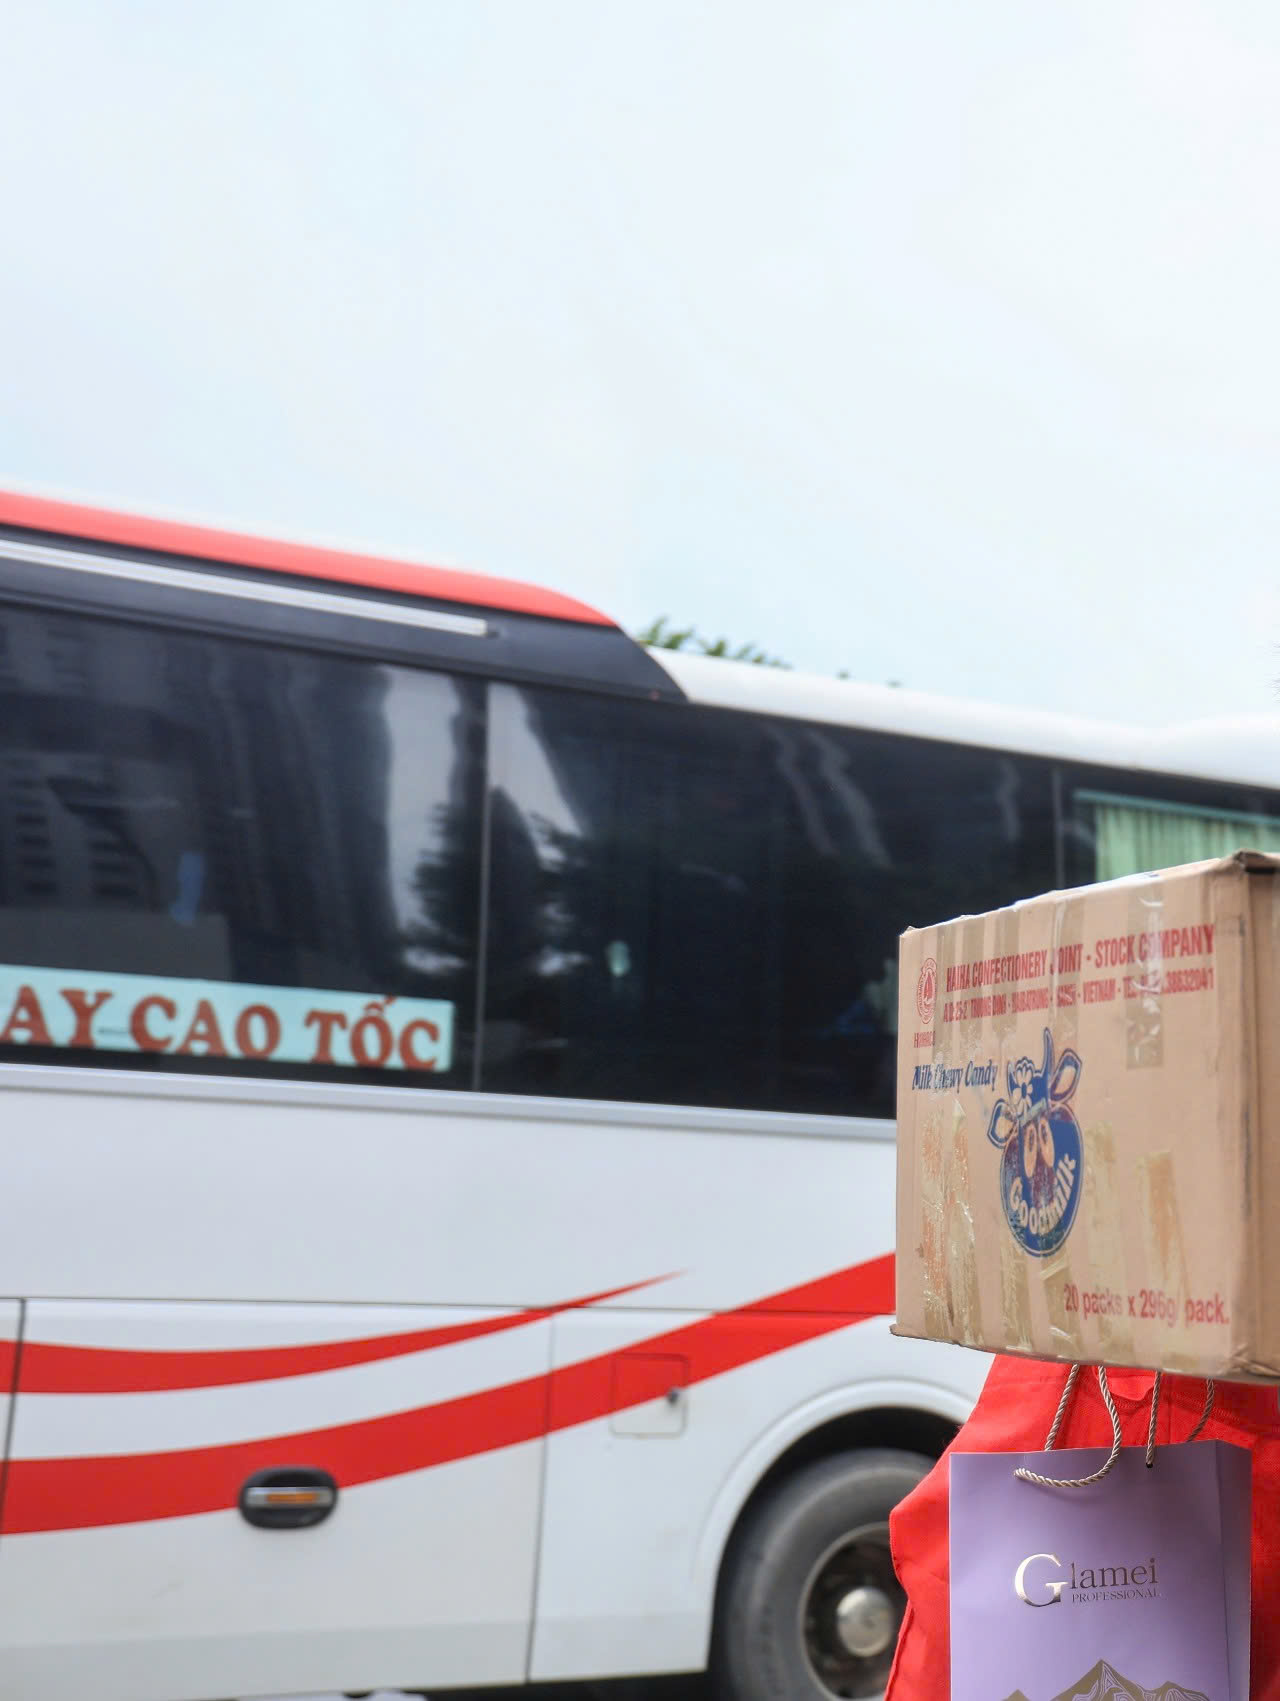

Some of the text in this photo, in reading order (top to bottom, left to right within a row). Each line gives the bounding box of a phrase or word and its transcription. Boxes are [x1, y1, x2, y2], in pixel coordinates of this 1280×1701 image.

[972, 950, 1048, 987] CONFECTIONERY
[1095, 934, 1135, 969] STOCK
[1138, 924, 1215, 961] CMPANY
[129, 994, 282, 1061] CAO
[304, 995, 441, 1071] TỐC
[912, 1063, 933, 1091] Milk
[965, 1058, 999, 1092] Candy
[1064, 1282, 1079, 1313] 20
[1082, 1285, 1123, 1320] packs
[1127, 1294, 1136, 1318] x
[1014, 1553, 1160, 1608] Glamei
[1071, 1587, 1162, 1603] PROFESSIONAL
